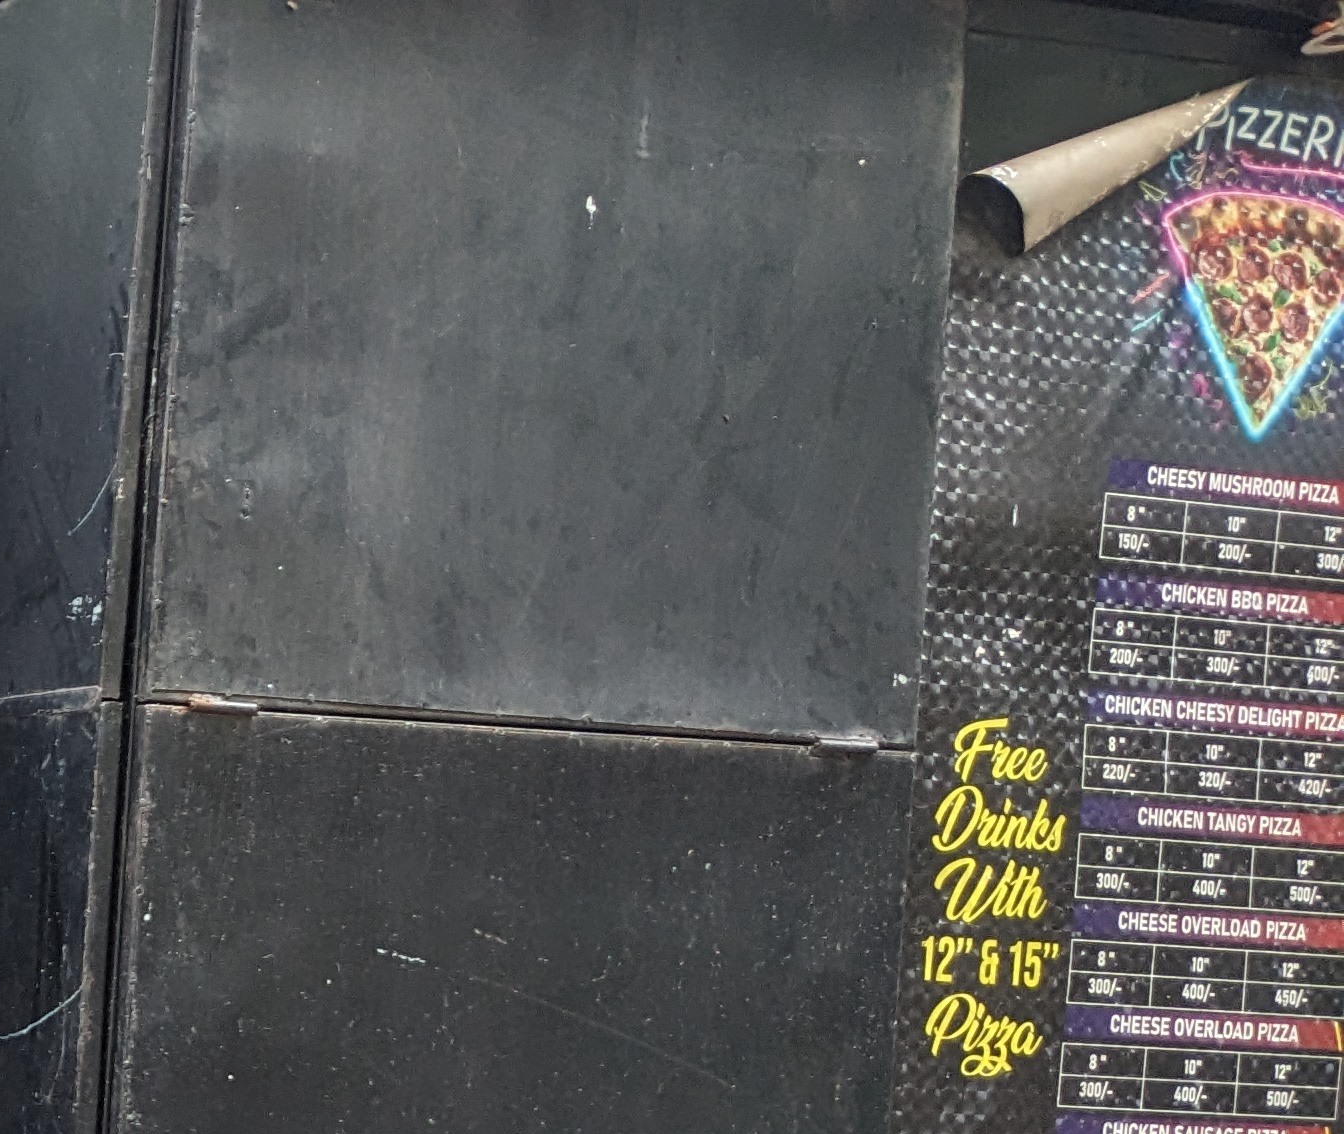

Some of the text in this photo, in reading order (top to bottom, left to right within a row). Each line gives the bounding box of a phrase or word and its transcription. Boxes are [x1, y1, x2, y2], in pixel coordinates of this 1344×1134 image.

[1147, 465, 1340, 504] CHEESY MUSHROOM PIZZA
[1317, 553, 1344, 571] 300/
[1161, 582, 1309, 614] CHICKEN BBQ PIZZA
[1104, 695, 1172, 717] CHICKEN
[1176, 701, 1234, 723] CHEESY
[1238, 706, 1301, 728] DELIGHT
[954, 717, 1048, 783] Free
[931, 784, 1067, 852] Drinks
[1138, 807, 1302, 836] CHICKEN TANGY PIZZA
[934, 857, 1049, 923] With
[1117, 911, 1306, 941] CHEESE OVERLOAD PIZZA
[979, 941, 1000, 985] &
[925, 992, 1043, 1077] Pizza
[1110, 1014, 1299, 1043] CHEESE OVERLOAD PIZZA
